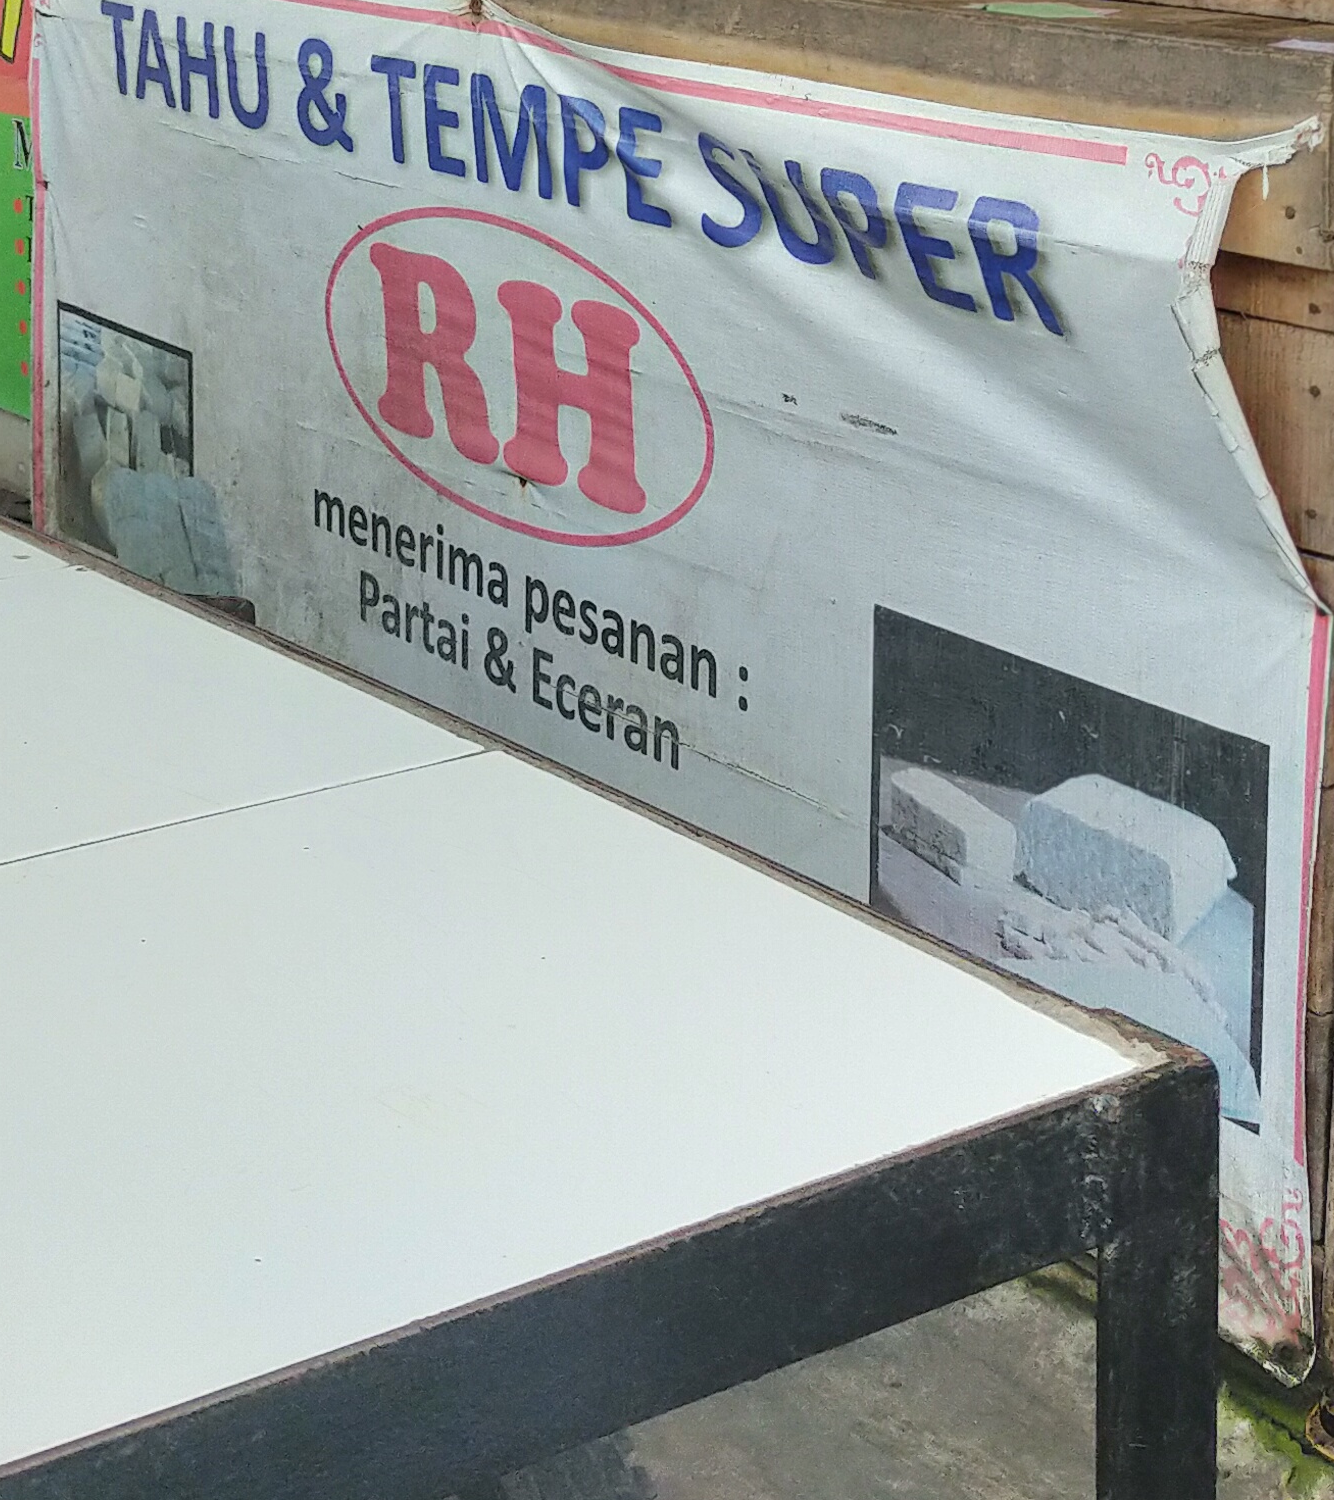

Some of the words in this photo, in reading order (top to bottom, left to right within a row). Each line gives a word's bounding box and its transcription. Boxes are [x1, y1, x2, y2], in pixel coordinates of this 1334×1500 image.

[100, 0, 269, 130] TAHU
[297, 38, 354, 153] &
[372, 53, 672, 230] TEMPE
[697, 131, 1065, 336] SUPER
[370, 240, 649, 516] RH
[313, 488, 509, 608] menerima
[524, 574, 717, 698] pesanan
[359, 569, 470, 671] Partai
[484, 626, 517, 694] &
[532, 647, 680, 771] Eceran
